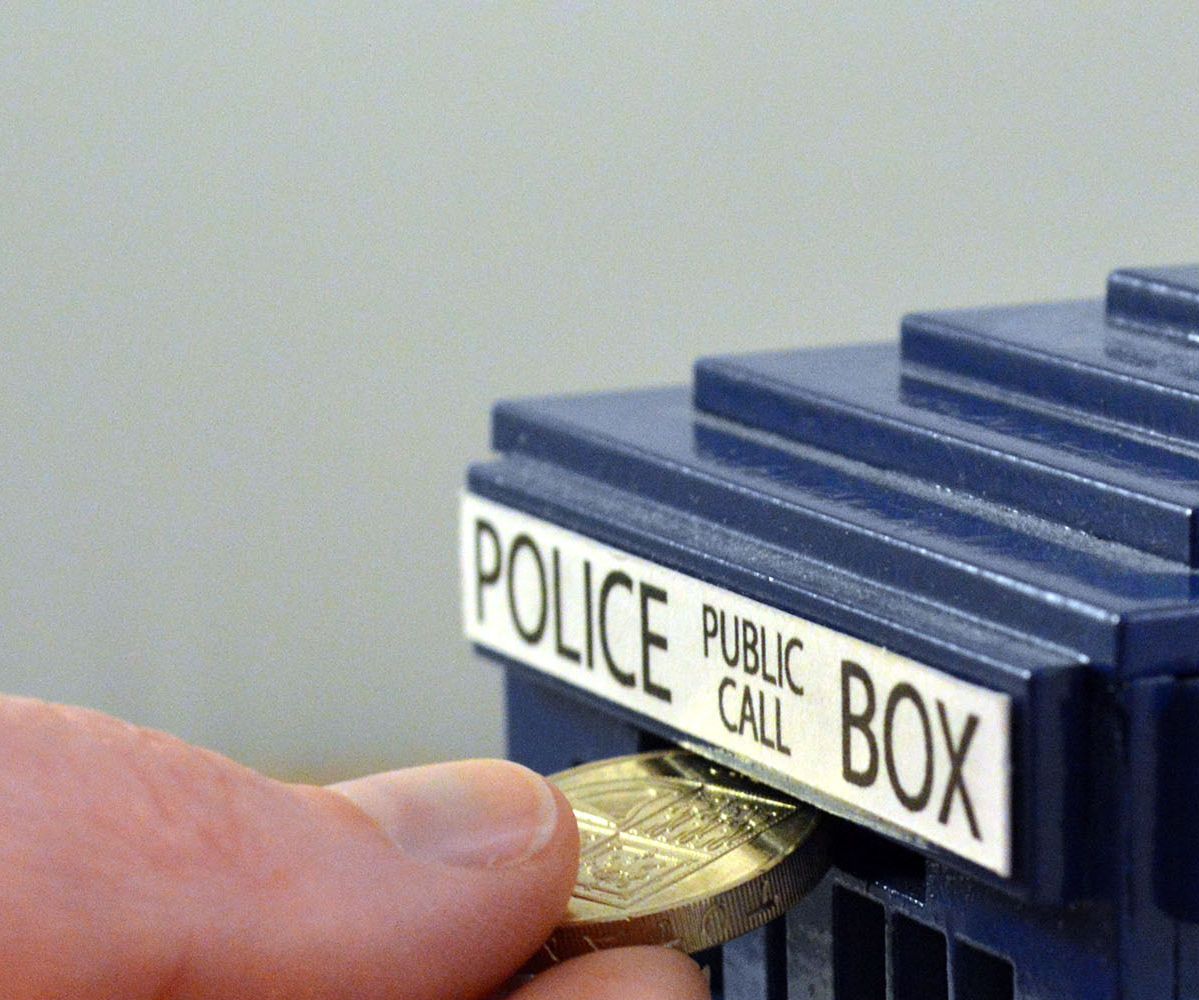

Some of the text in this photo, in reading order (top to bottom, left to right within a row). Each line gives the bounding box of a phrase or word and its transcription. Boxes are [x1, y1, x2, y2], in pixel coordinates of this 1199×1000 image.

[475, 517, 672, 703] POLICE
[702, 603, 804, 697] PUBLIC
[718, 676, 791, 756] CALL
[841, 659, 982, 842] BOX
